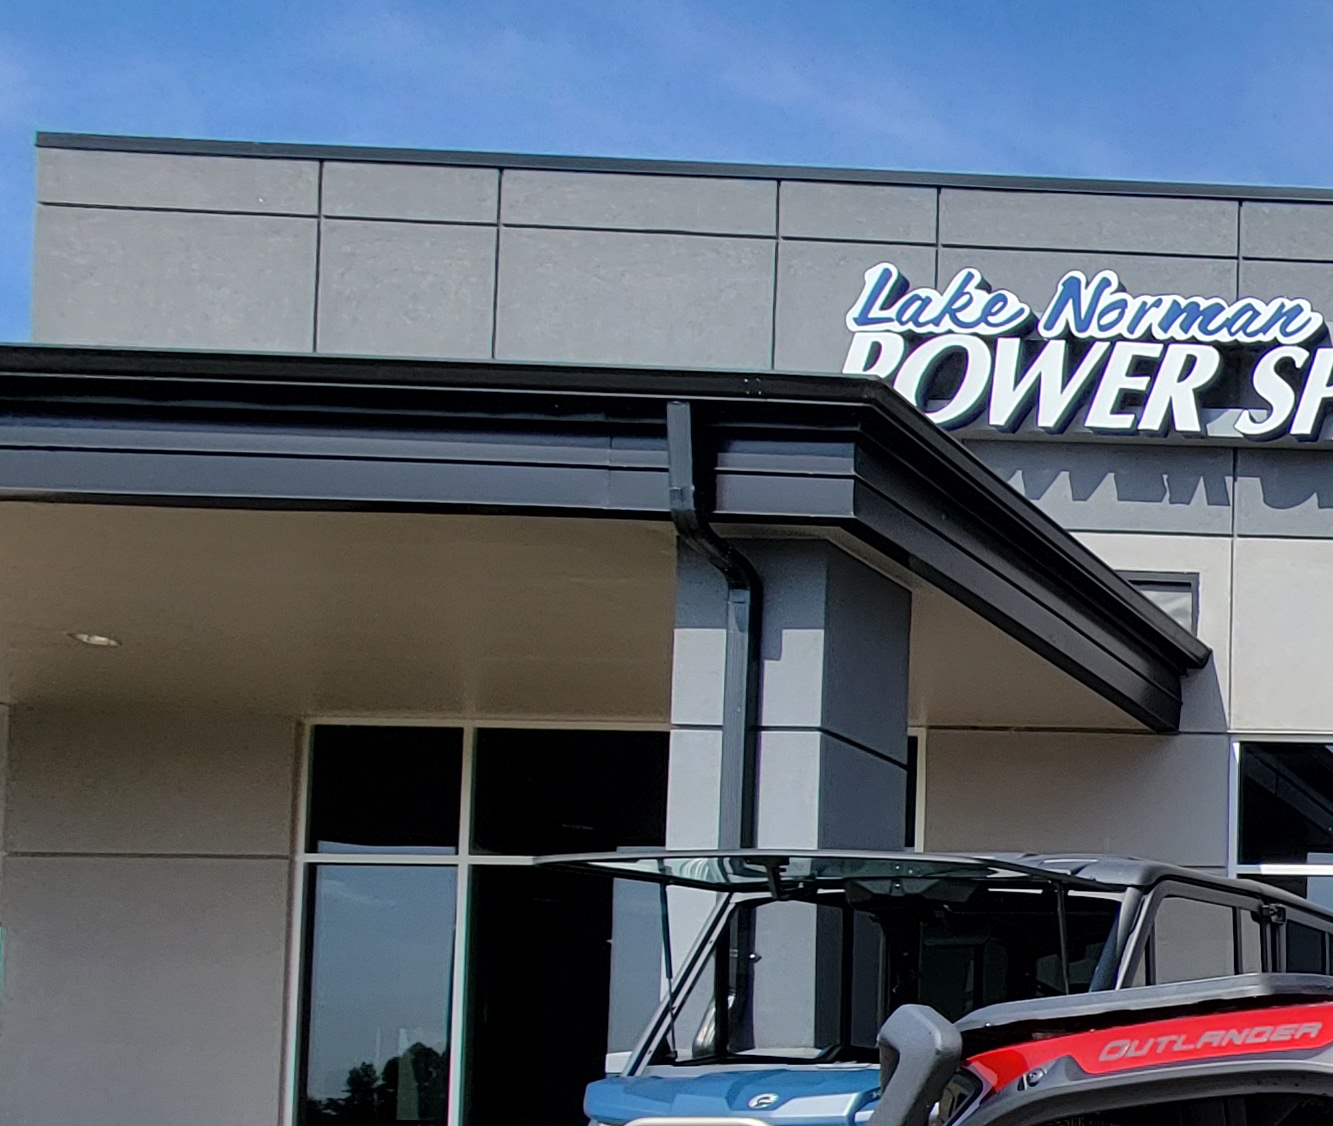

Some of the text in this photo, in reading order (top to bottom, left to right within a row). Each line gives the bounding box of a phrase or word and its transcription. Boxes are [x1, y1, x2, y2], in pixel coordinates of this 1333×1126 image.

[846, 261, 1324, 344] Lake Norman
[842, 331, 1222, 433] POWER
[1098, 1021, 1323, 1062] OUTLANDER
